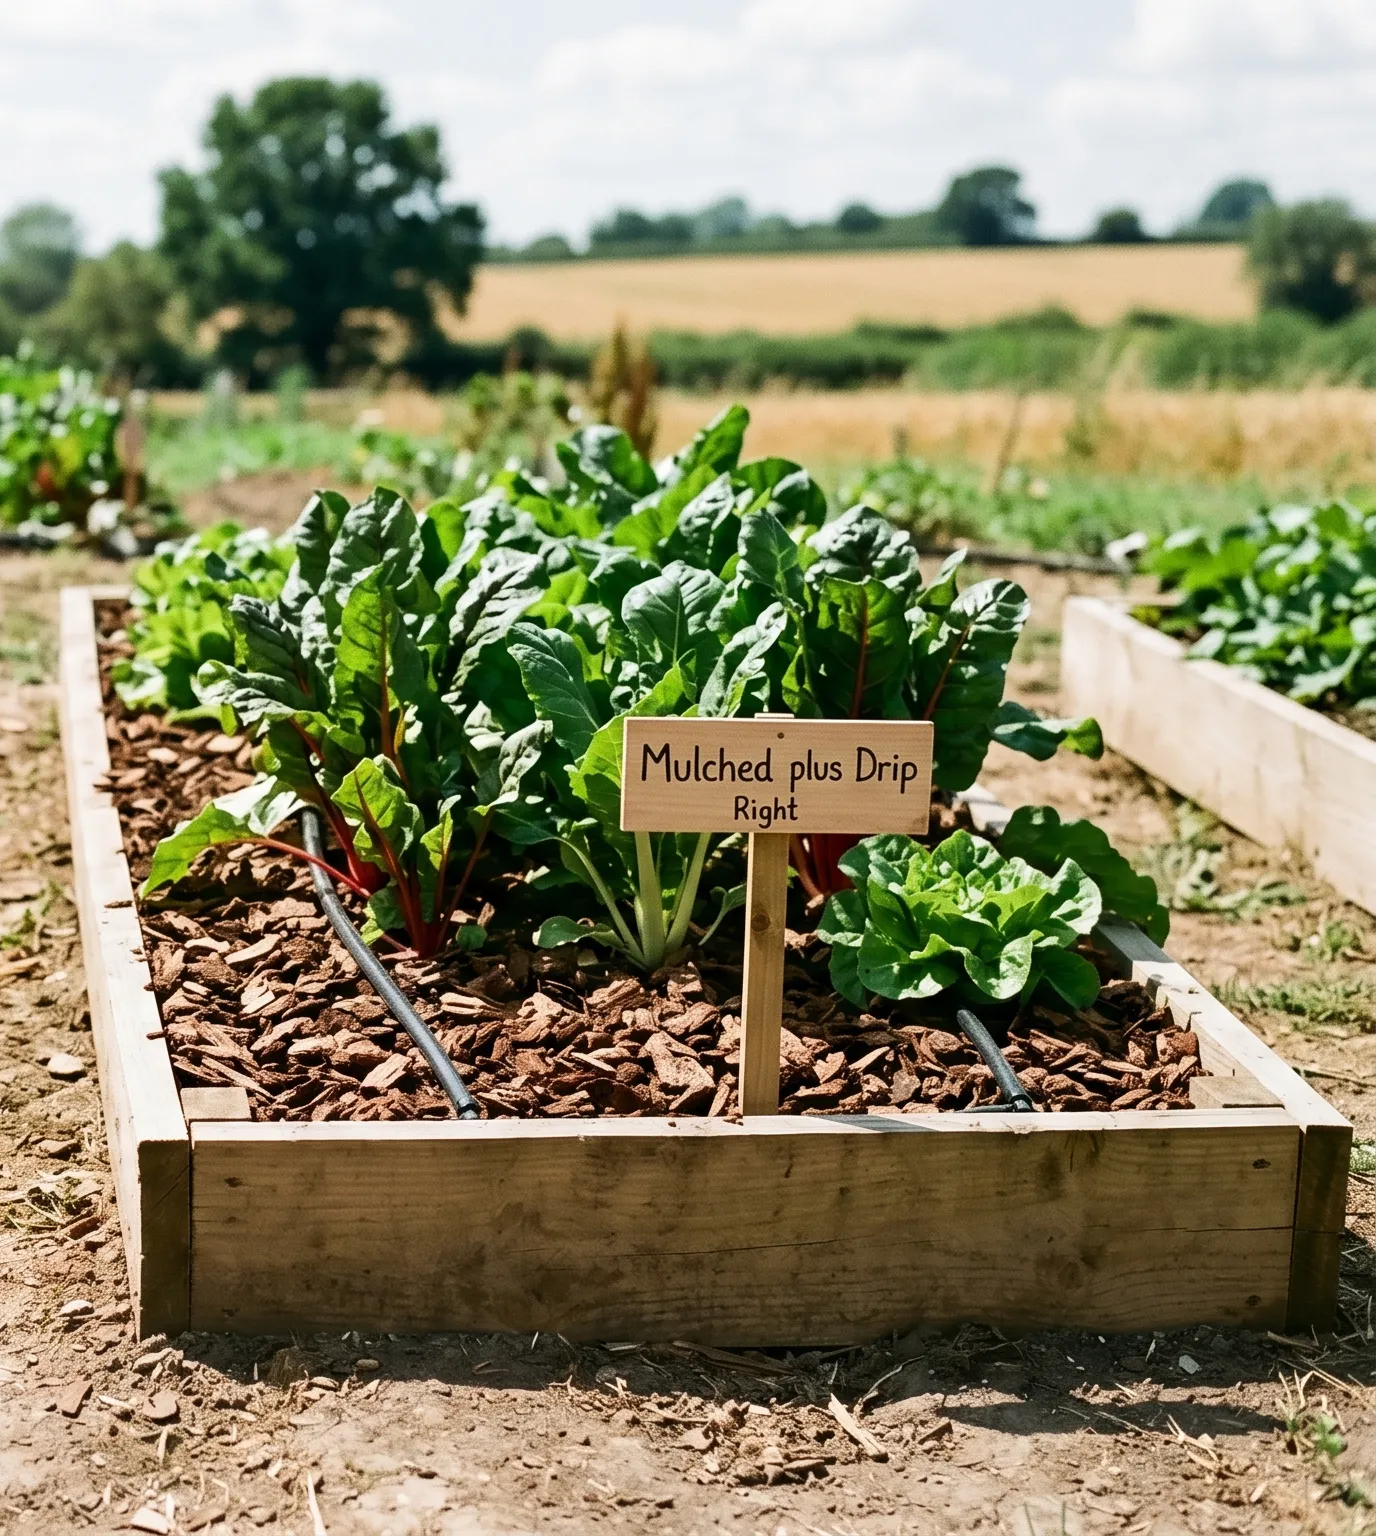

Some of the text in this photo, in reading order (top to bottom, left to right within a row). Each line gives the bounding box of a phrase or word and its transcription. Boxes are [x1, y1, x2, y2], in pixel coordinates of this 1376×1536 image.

[640, 742, 918, 794] Mulched plus Drip
[733, 795, 799, 829] Right
